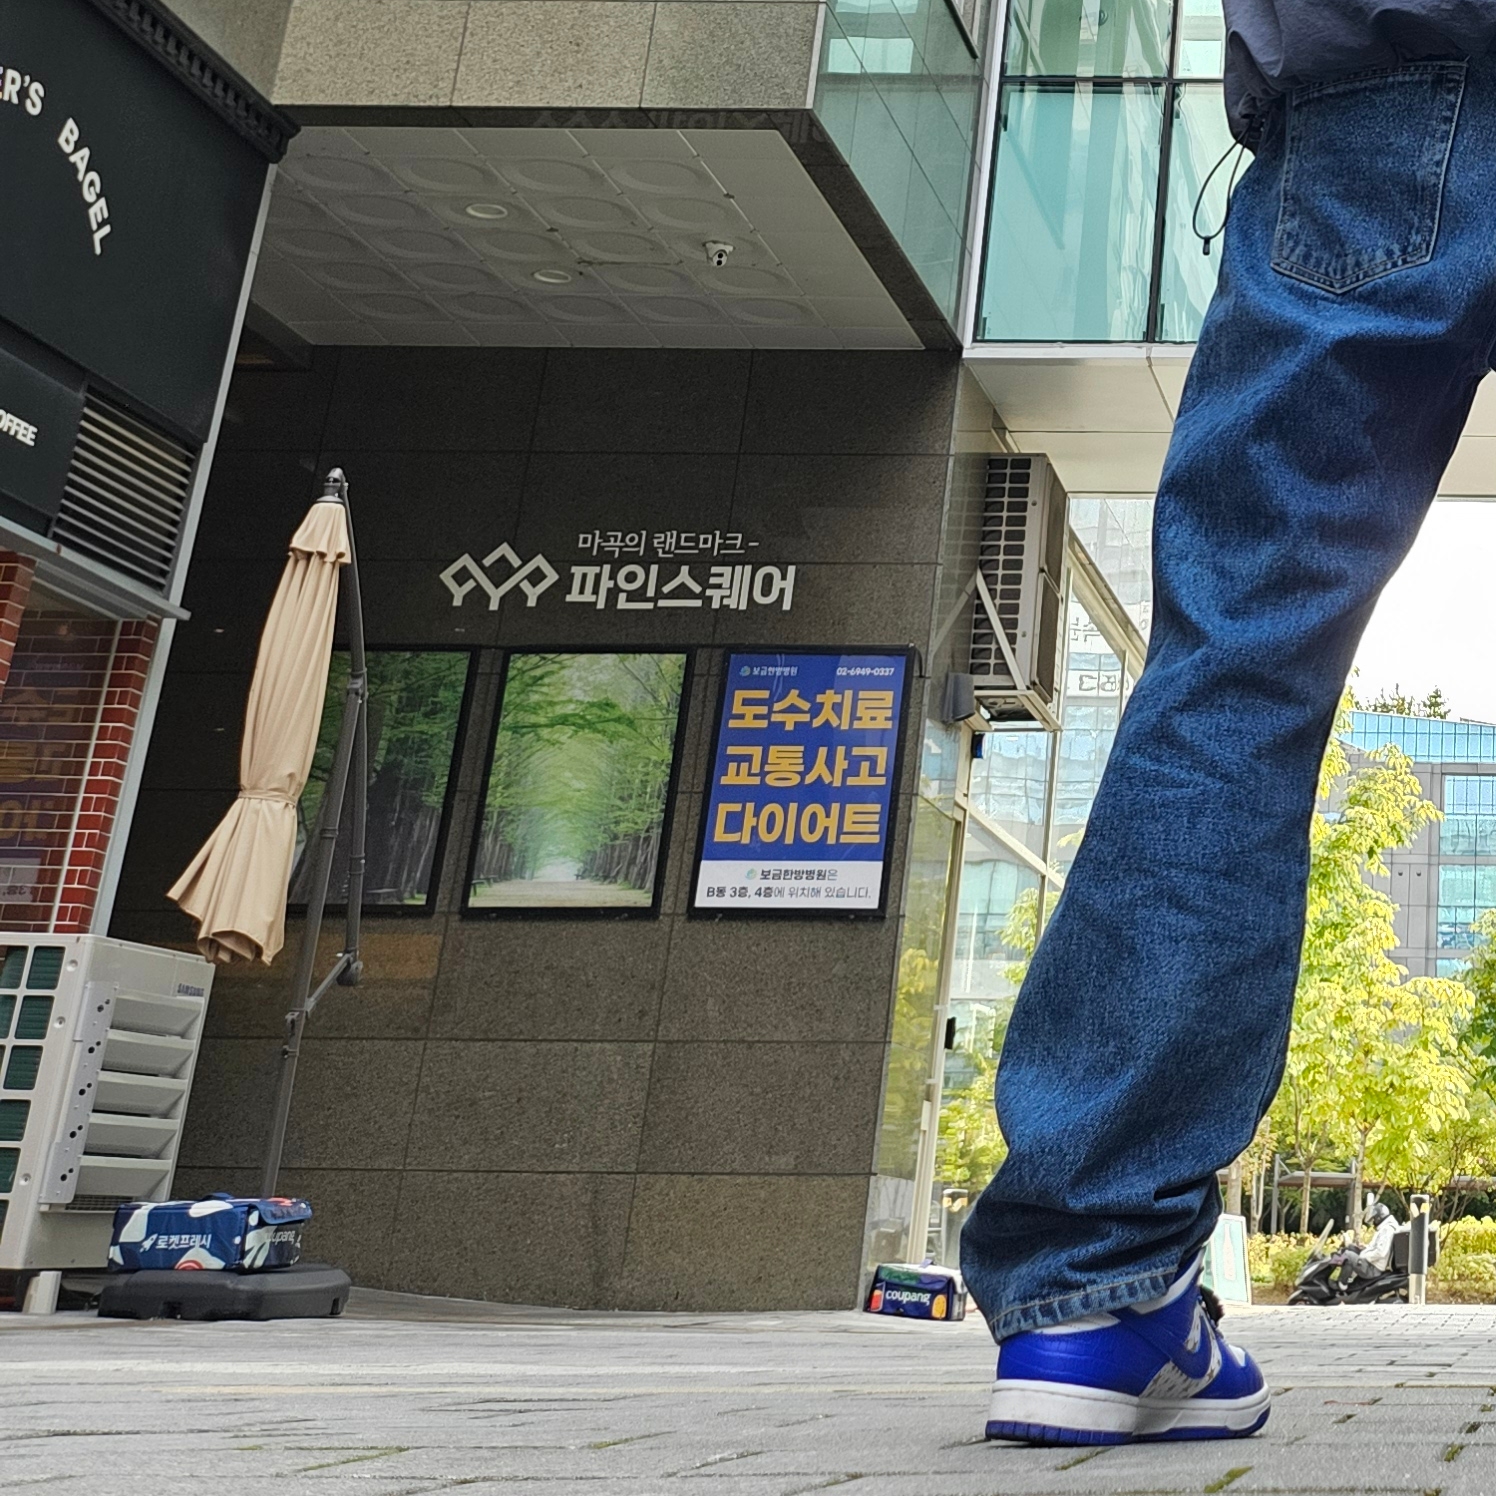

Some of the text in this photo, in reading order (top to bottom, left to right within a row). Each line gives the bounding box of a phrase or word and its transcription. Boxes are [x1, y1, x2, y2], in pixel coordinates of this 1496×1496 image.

[57, 117, 111, 256] BAGEL
[577, 529, 647, 558] 마곡의
[565, 561, 797, 611] 파인스퀘어
[836, 666, 895, 677] 02-6949-0337
[728, 688, 895, 731] 도수치료
[719, 744, 889, 788] 교통사고
[713, 801, 883, 846] 다이어트
[759, 868, 839, 882] 보금한방병원은
[706, 886, 727, 899] B동
[754, 886, 785, 899] 4층에
[787, 887, 821, 900] 위치해
[824, 887, 872, 900] 있습니다.
[155, 1233, 213, 1251] 로켓프레시
[885, 1289, 932, 1306] coupang
